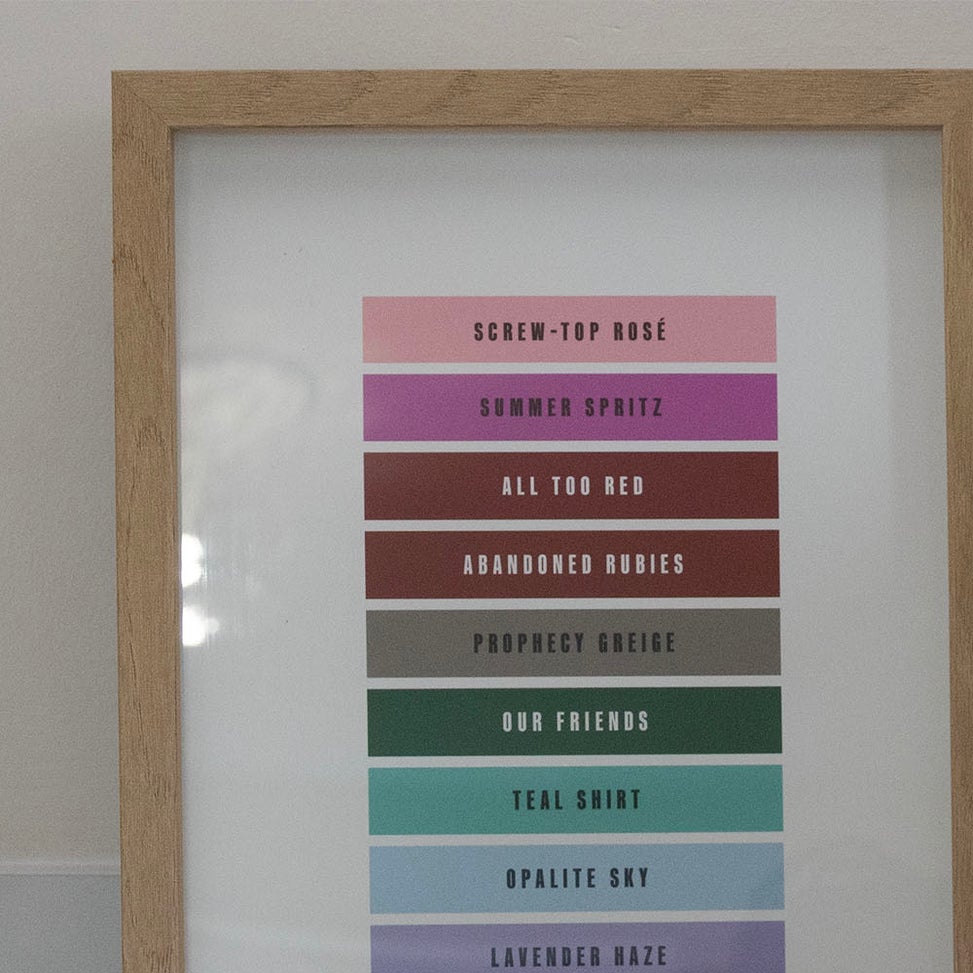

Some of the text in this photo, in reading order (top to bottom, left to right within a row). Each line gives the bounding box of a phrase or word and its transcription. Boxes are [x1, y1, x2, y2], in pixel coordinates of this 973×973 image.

[474, 318, 665, 341] SCREW-TOP ROSÉ
[481, 398, 661, 417] SUMMER SPRITZ
[503, 476, 642, 495] ALL TOO RED
[464, 554, 683, 574] ABANDONED RUBIES
[474, 632, 674, 653] PROPHECY GREIGE
[503, 711, 648, 732] OUR FRIENDS
[513, 789, 640, 810] TEAL SHIRT
[507, 868, 647, 889] OPALITE SKY
[491, 946, 666, 967] LAVENDER HAZE
